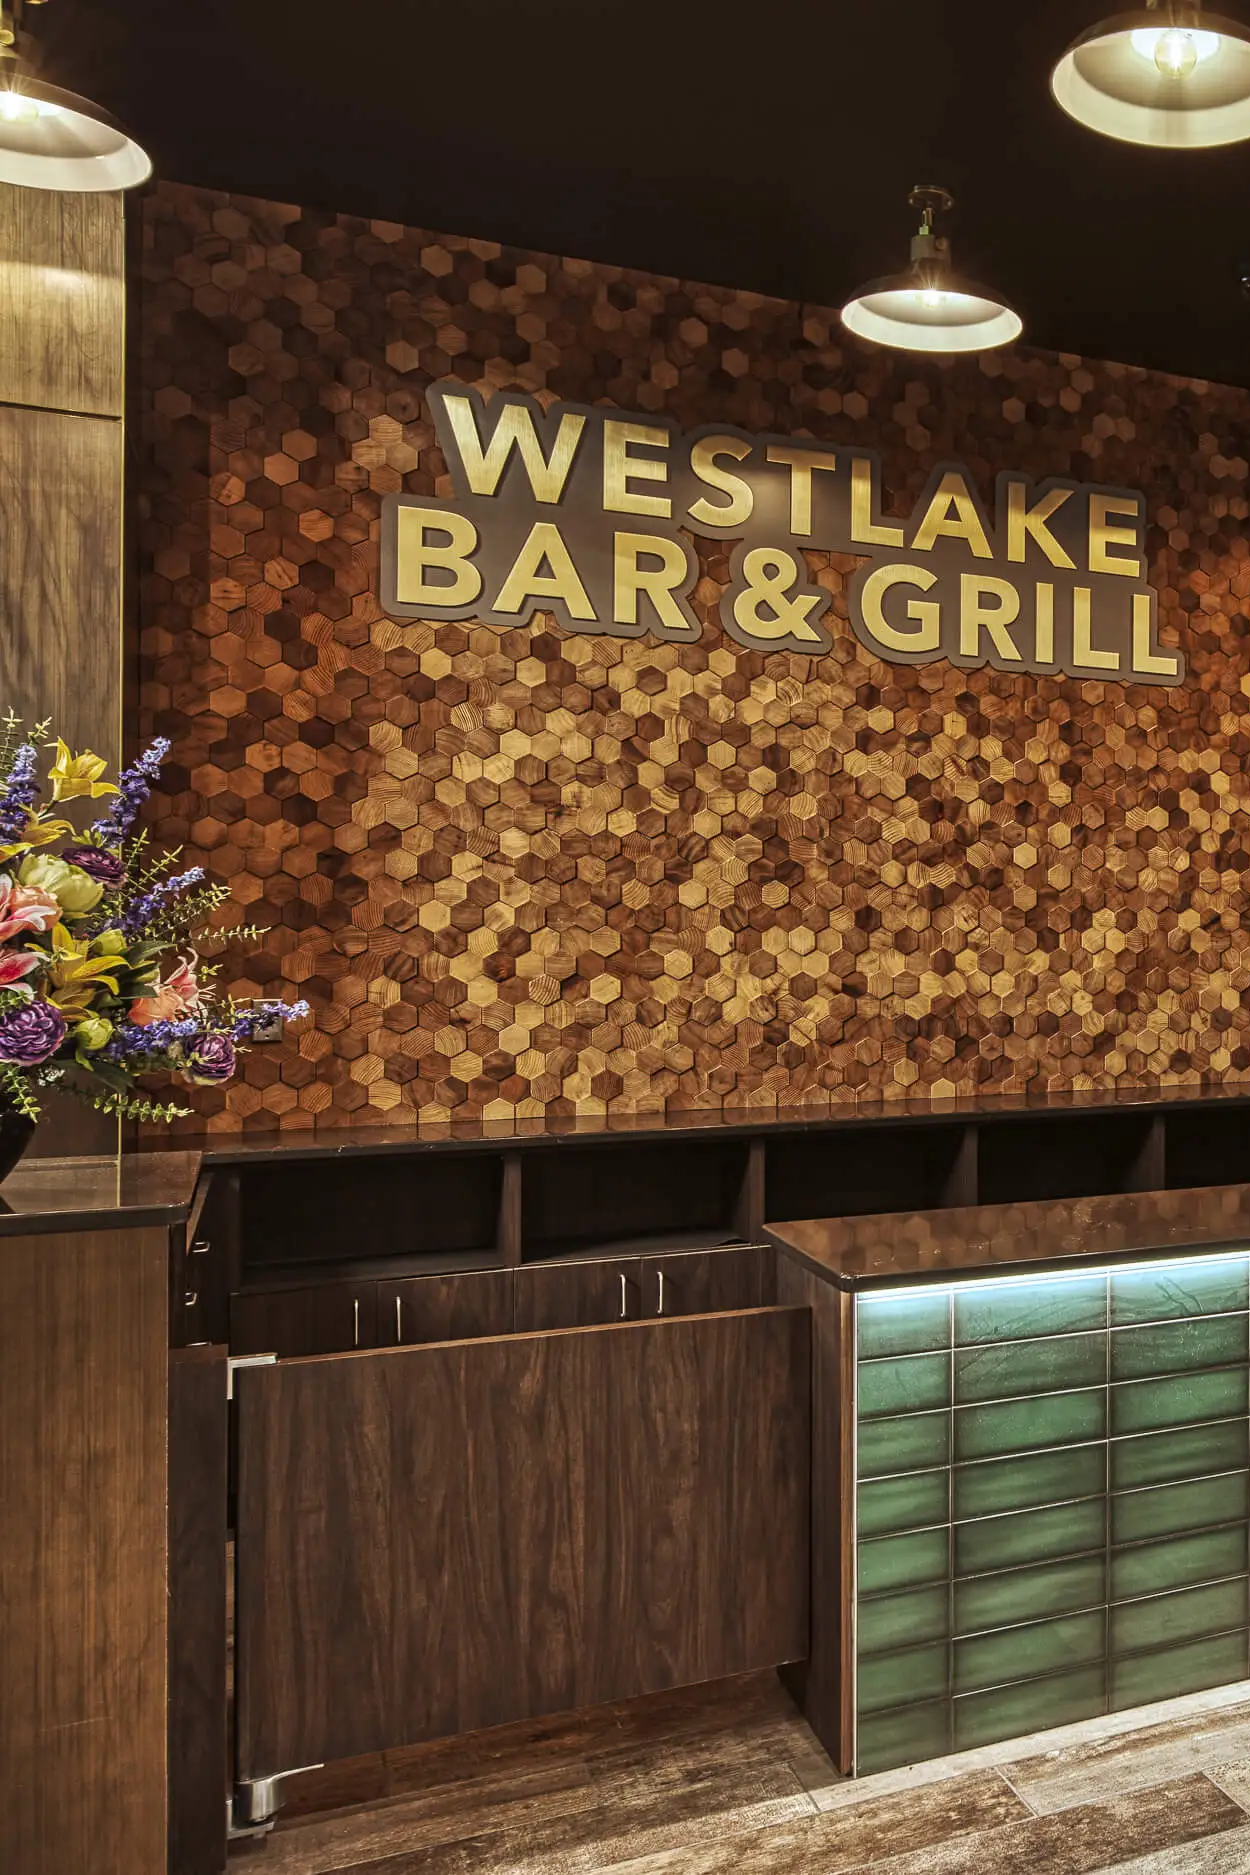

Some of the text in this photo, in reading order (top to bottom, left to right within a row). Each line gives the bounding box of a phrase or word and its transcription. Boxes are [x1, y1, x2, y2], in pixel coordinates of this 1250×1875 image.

[441, 394, 1141, 577] WESTLAKE
[396, 505, 1179, 676] BAR & GRILL
